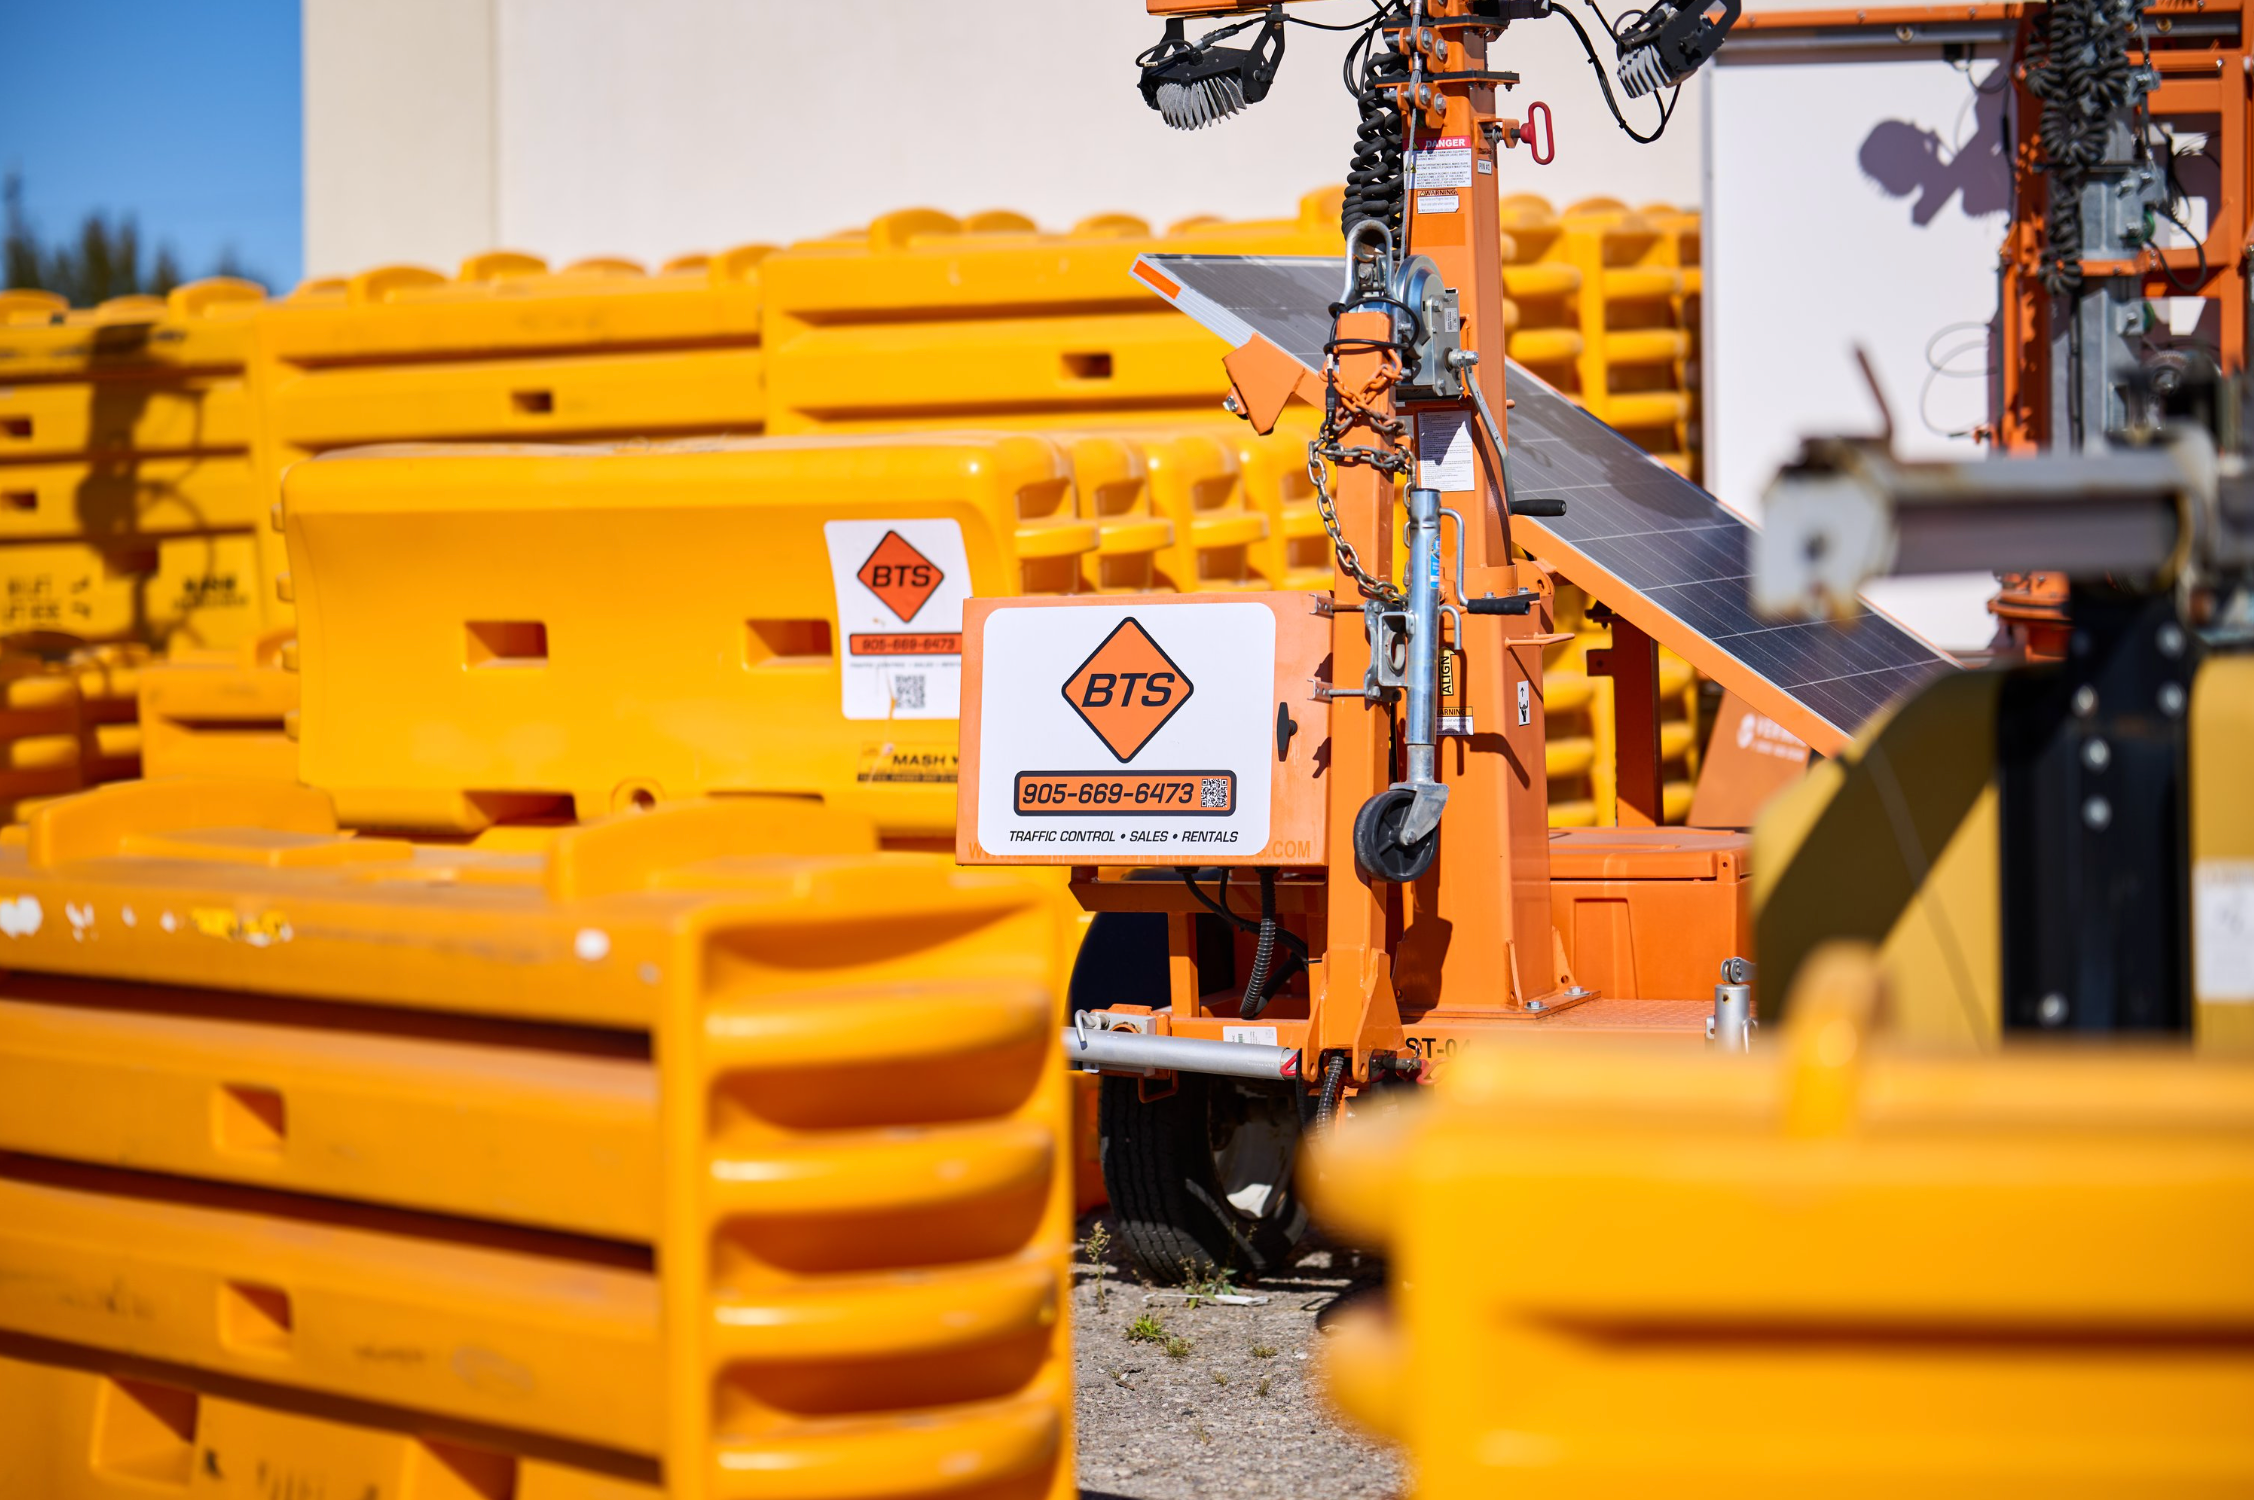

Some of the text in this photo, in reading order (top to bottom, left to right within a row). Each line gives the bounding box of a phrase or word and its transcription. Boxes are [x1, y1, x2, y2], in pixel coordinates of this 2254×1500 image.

[1425, 139, 1464, 148] DANGER
[872, 566, 932, 588] BTS
[1442, 656, 1451, 676] ALIGN
[1081, 672, 1176, 708] BTS
[892, 755, 946, 766] MASH
[1022, 783, 1195, 805] 905-669-6473
[1009, 830, 1239, 843] TRAFFIC CONTROL SALES RENTALS
